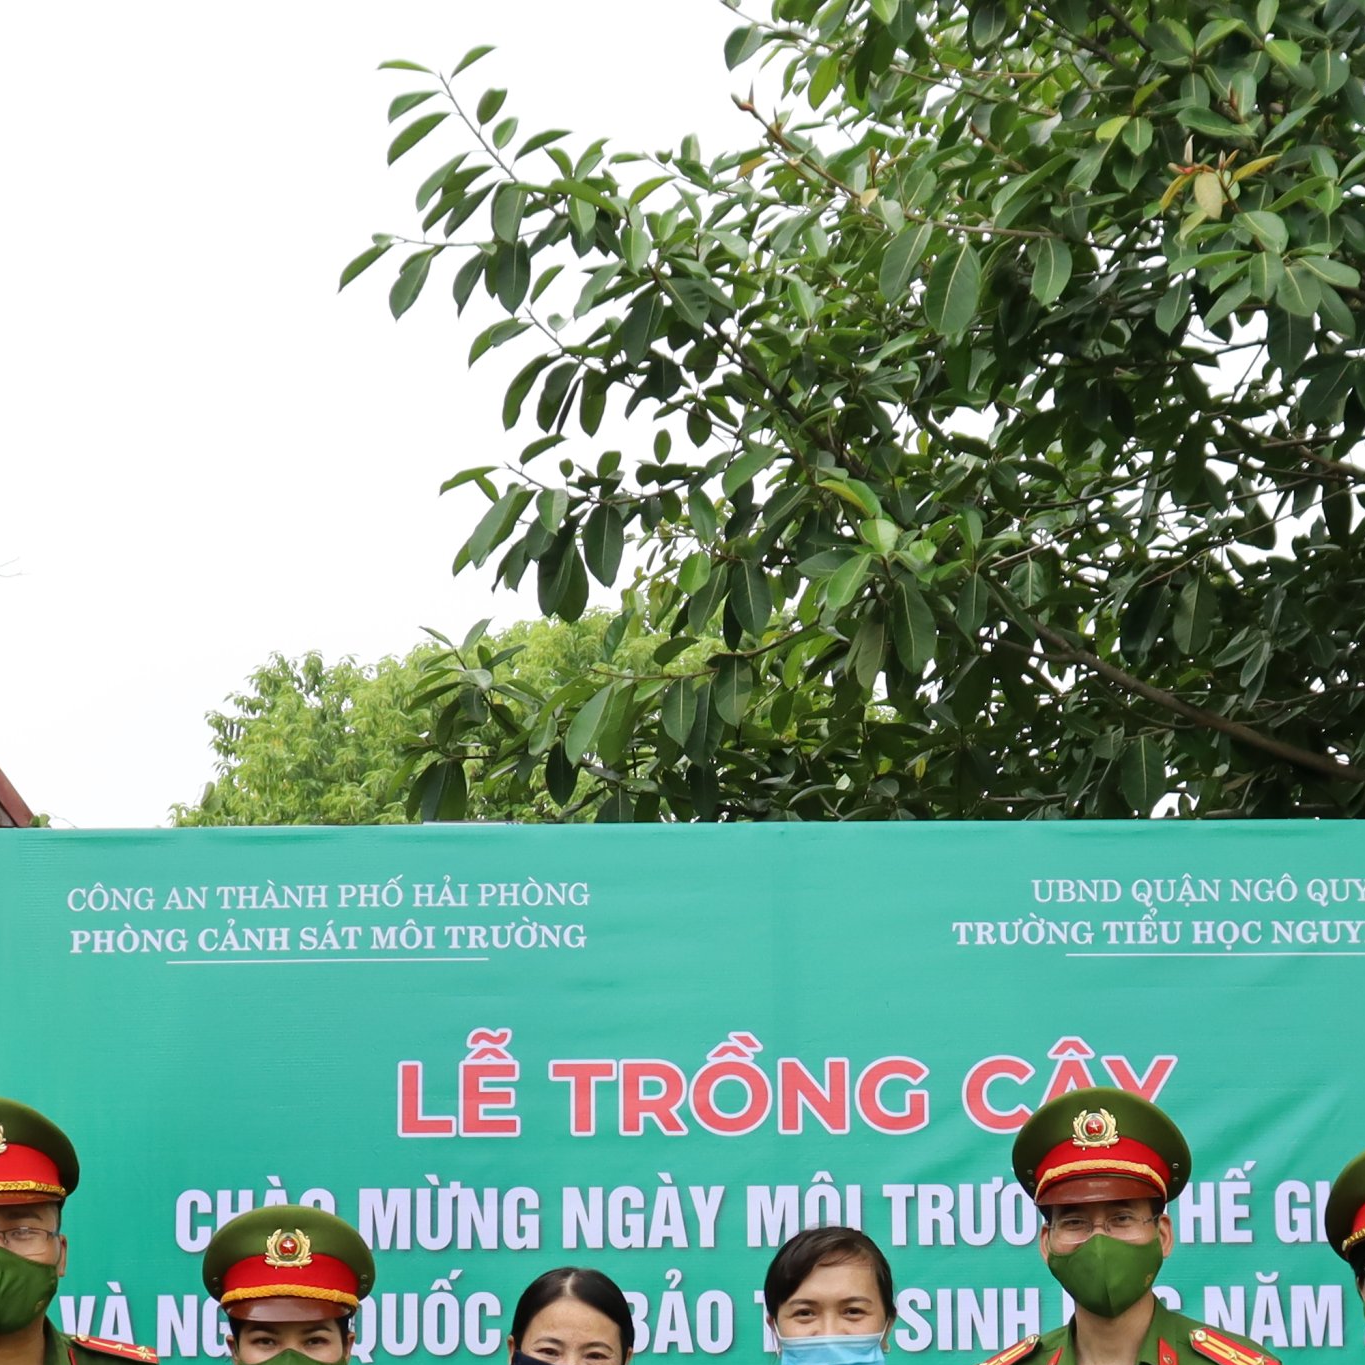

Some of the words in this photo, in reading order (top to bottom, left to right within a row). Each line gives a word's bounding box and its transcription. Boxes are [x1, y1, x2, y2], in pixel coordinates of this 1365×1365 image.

[67, 881, 156, 912] CÔNG
[163, 886, 209, 911] AN
[216, 879, 329, 909] THÀNH
[338, 874, 404, 908] PHỐ
[412, 874, 469, 907] HẢI
[477, 876, 591, 907] PHÒNG
[1031, 879, 1123, 903] UBND
[1131, 873, 1222, 907] QUẬN
[1230, 872, 1298, 902] NGÔ
[69, 922, 188, 953] PHÒNG
[197, 918, 291, 951] CẢNH
[299, 919, 363, 951] SÁT
[370, 918, 437, 950] MÔI
[444, 916, 587, 949] TRƯỜNG
[951, 912, 1095, 945] TRƯỜNG
[1102, 907, 1183, 944] TIỂU
[1191, 920, 1263, 950] HỌC
[397, 1027, 521, 1139] LỄ
[548, 1031, 931, 1138] TRỒNG
[961, 1035, 1179, 1136] CÂY
[358, 1174, 540, 1251] MỪNG
[561, 1172, 725, 1249] NGÀY
[746, 1170, 862, 1248] MÔI
[1274, 1180, 1333, 1244] GI
[59, 1281, 135, 1346] VÀ
[894, 1287, 1040, 1352] SINH
[1203, 1271, 1344, 1348] NĂM
